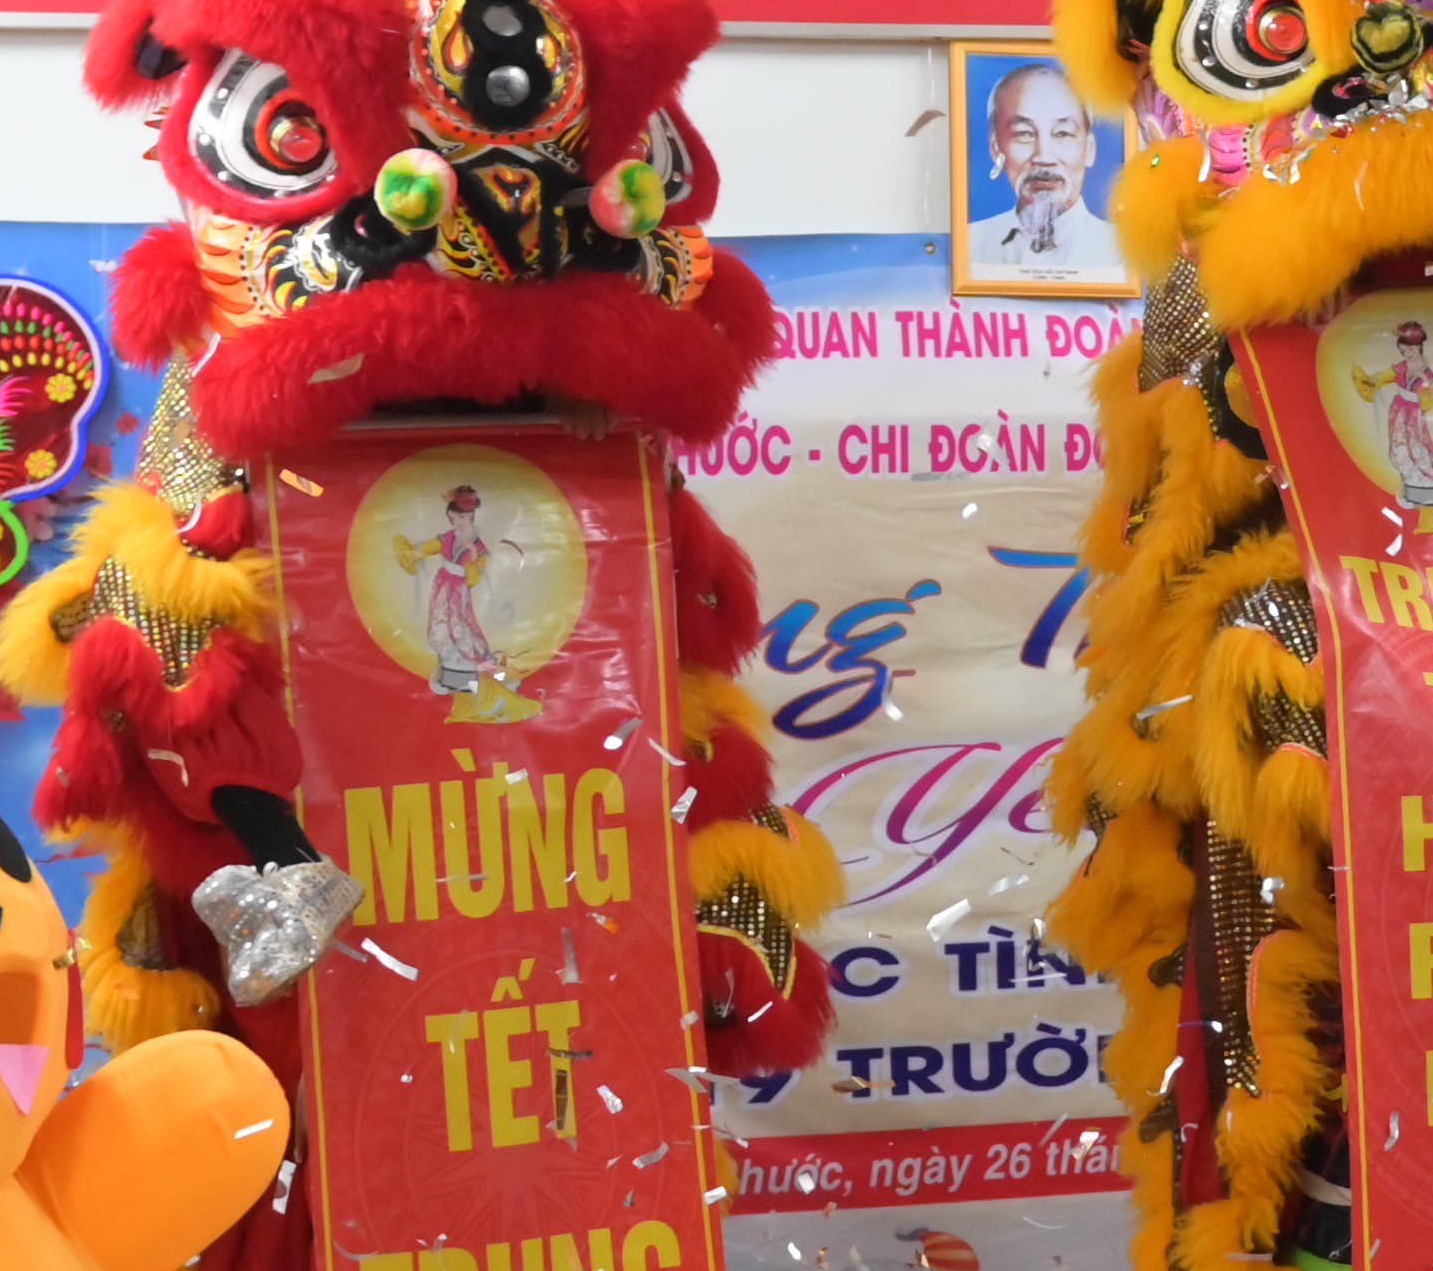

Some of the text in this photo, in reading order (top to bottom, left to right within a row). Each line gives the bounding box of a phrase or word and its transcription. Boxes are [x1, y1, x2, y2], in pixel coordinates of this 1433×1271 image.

[895, 297, 1028, 358] THÀNH
[1045, 302, 1143, 358] ĐOÀ
[838, 425, 910, 474] CHI
[928, 409, 1045, 472] ĐOÀN
[344, 748, 632, 927] MỪNG
[944, 925, 1106, 991] TÌN
[424, 957, 581, 1152] TẾT
[837, 1023, 1115, 1101] TRƯỜ
[739, 1153, 853, 1197] hước,
[869, 1146, 972, 1195] ngày
[984, 1143, 1031, 1180] 26
